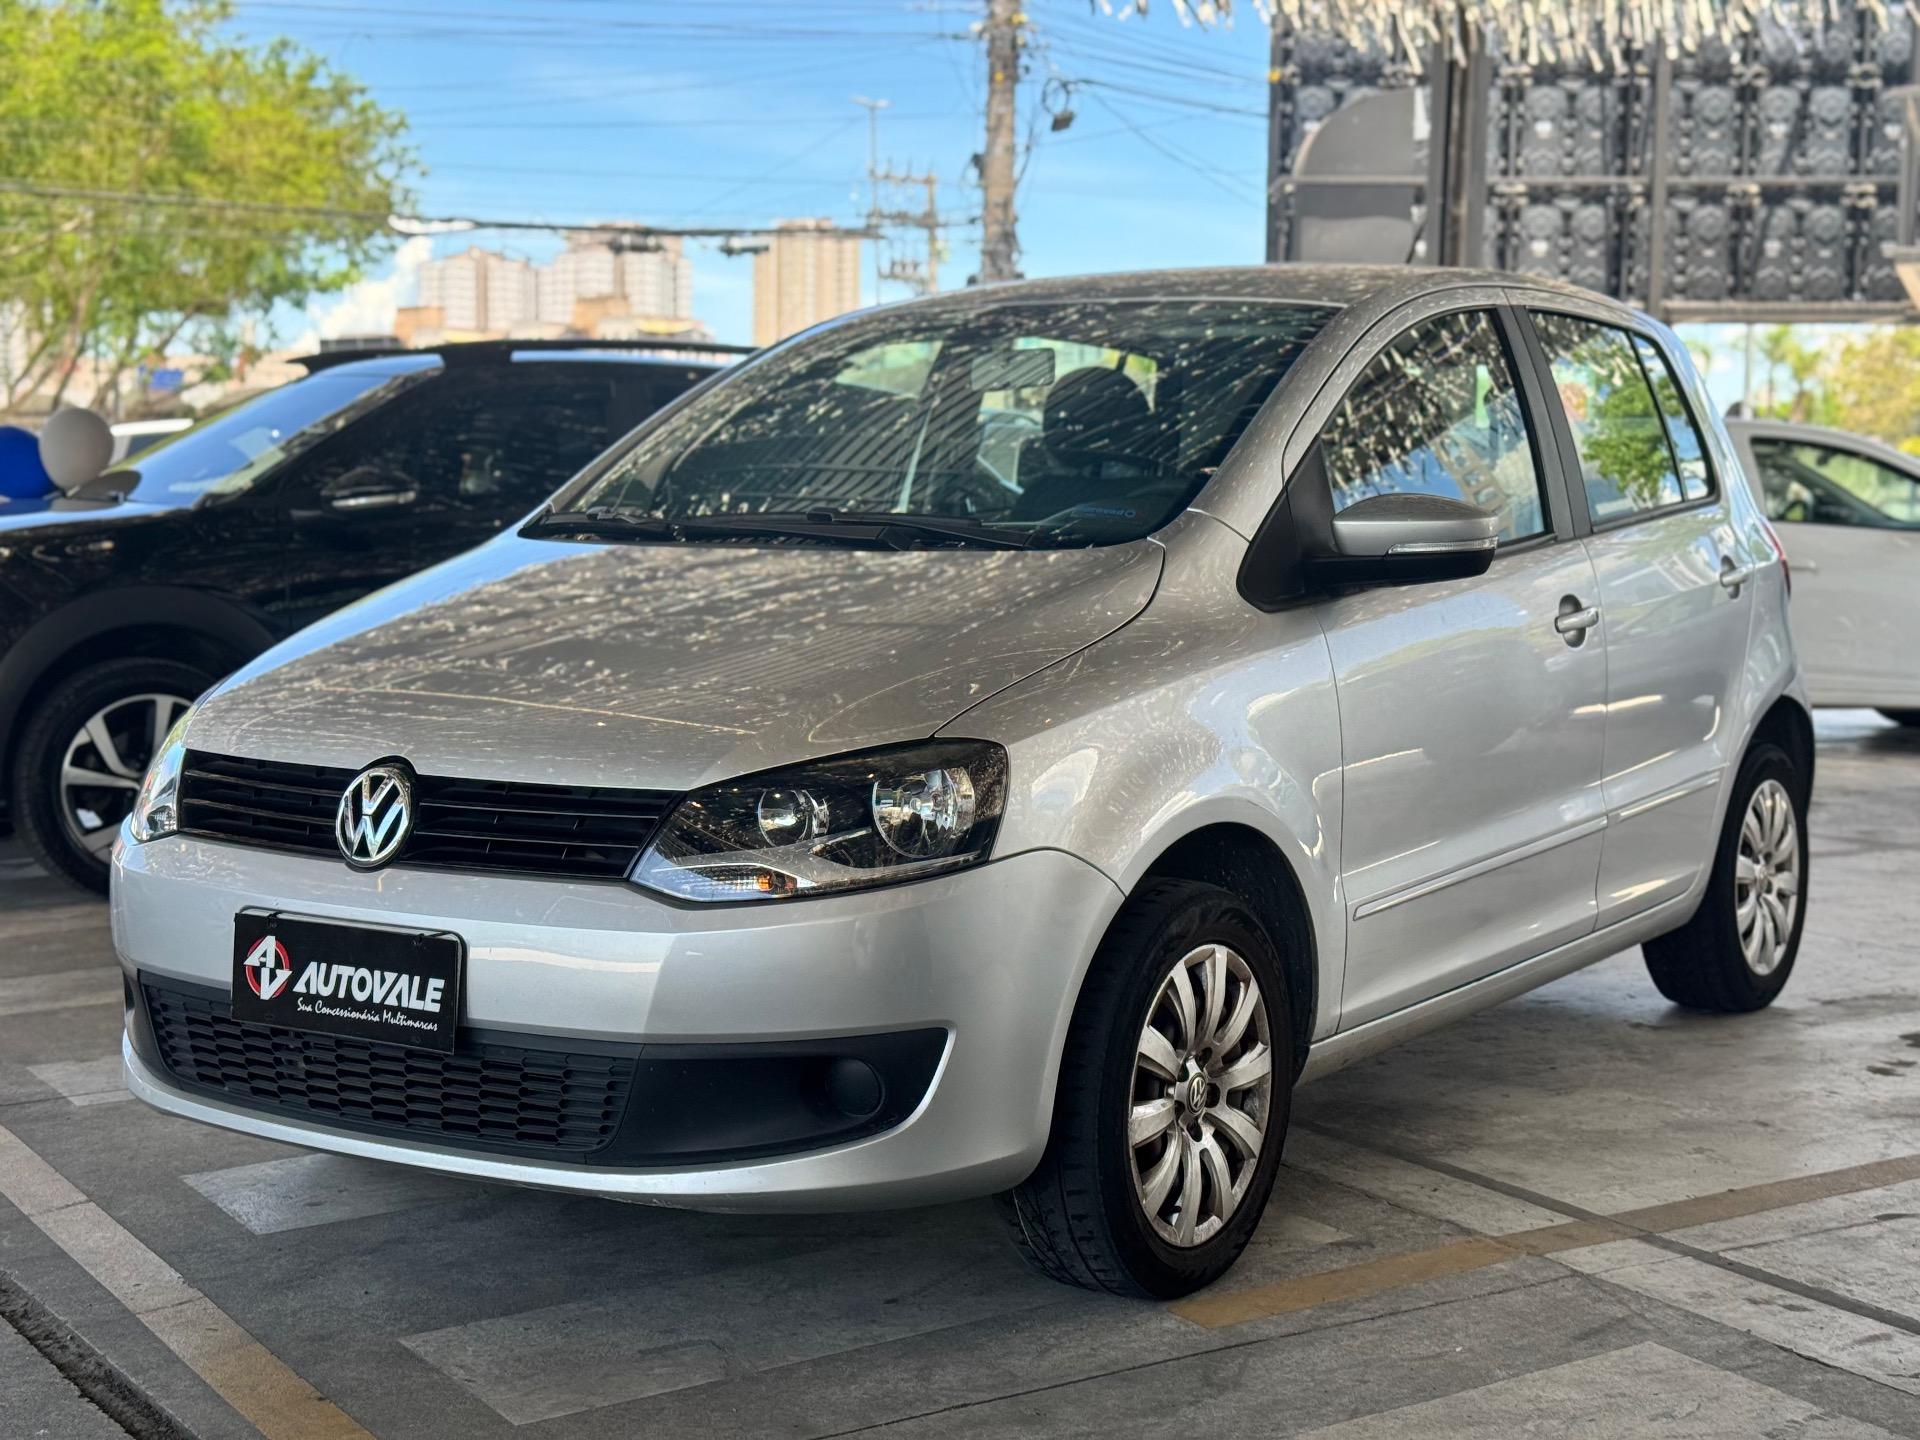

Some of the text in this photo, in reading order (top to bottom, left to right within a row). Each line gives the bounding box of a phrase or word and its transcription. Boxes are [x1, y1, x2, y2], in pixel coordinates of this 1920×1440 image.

[340, 771, 408, 861] VW
[292, 961, 446, 1013] AUTOVALE
[297, 997, 439, 1031] Sua Concessionária Multimarcas
